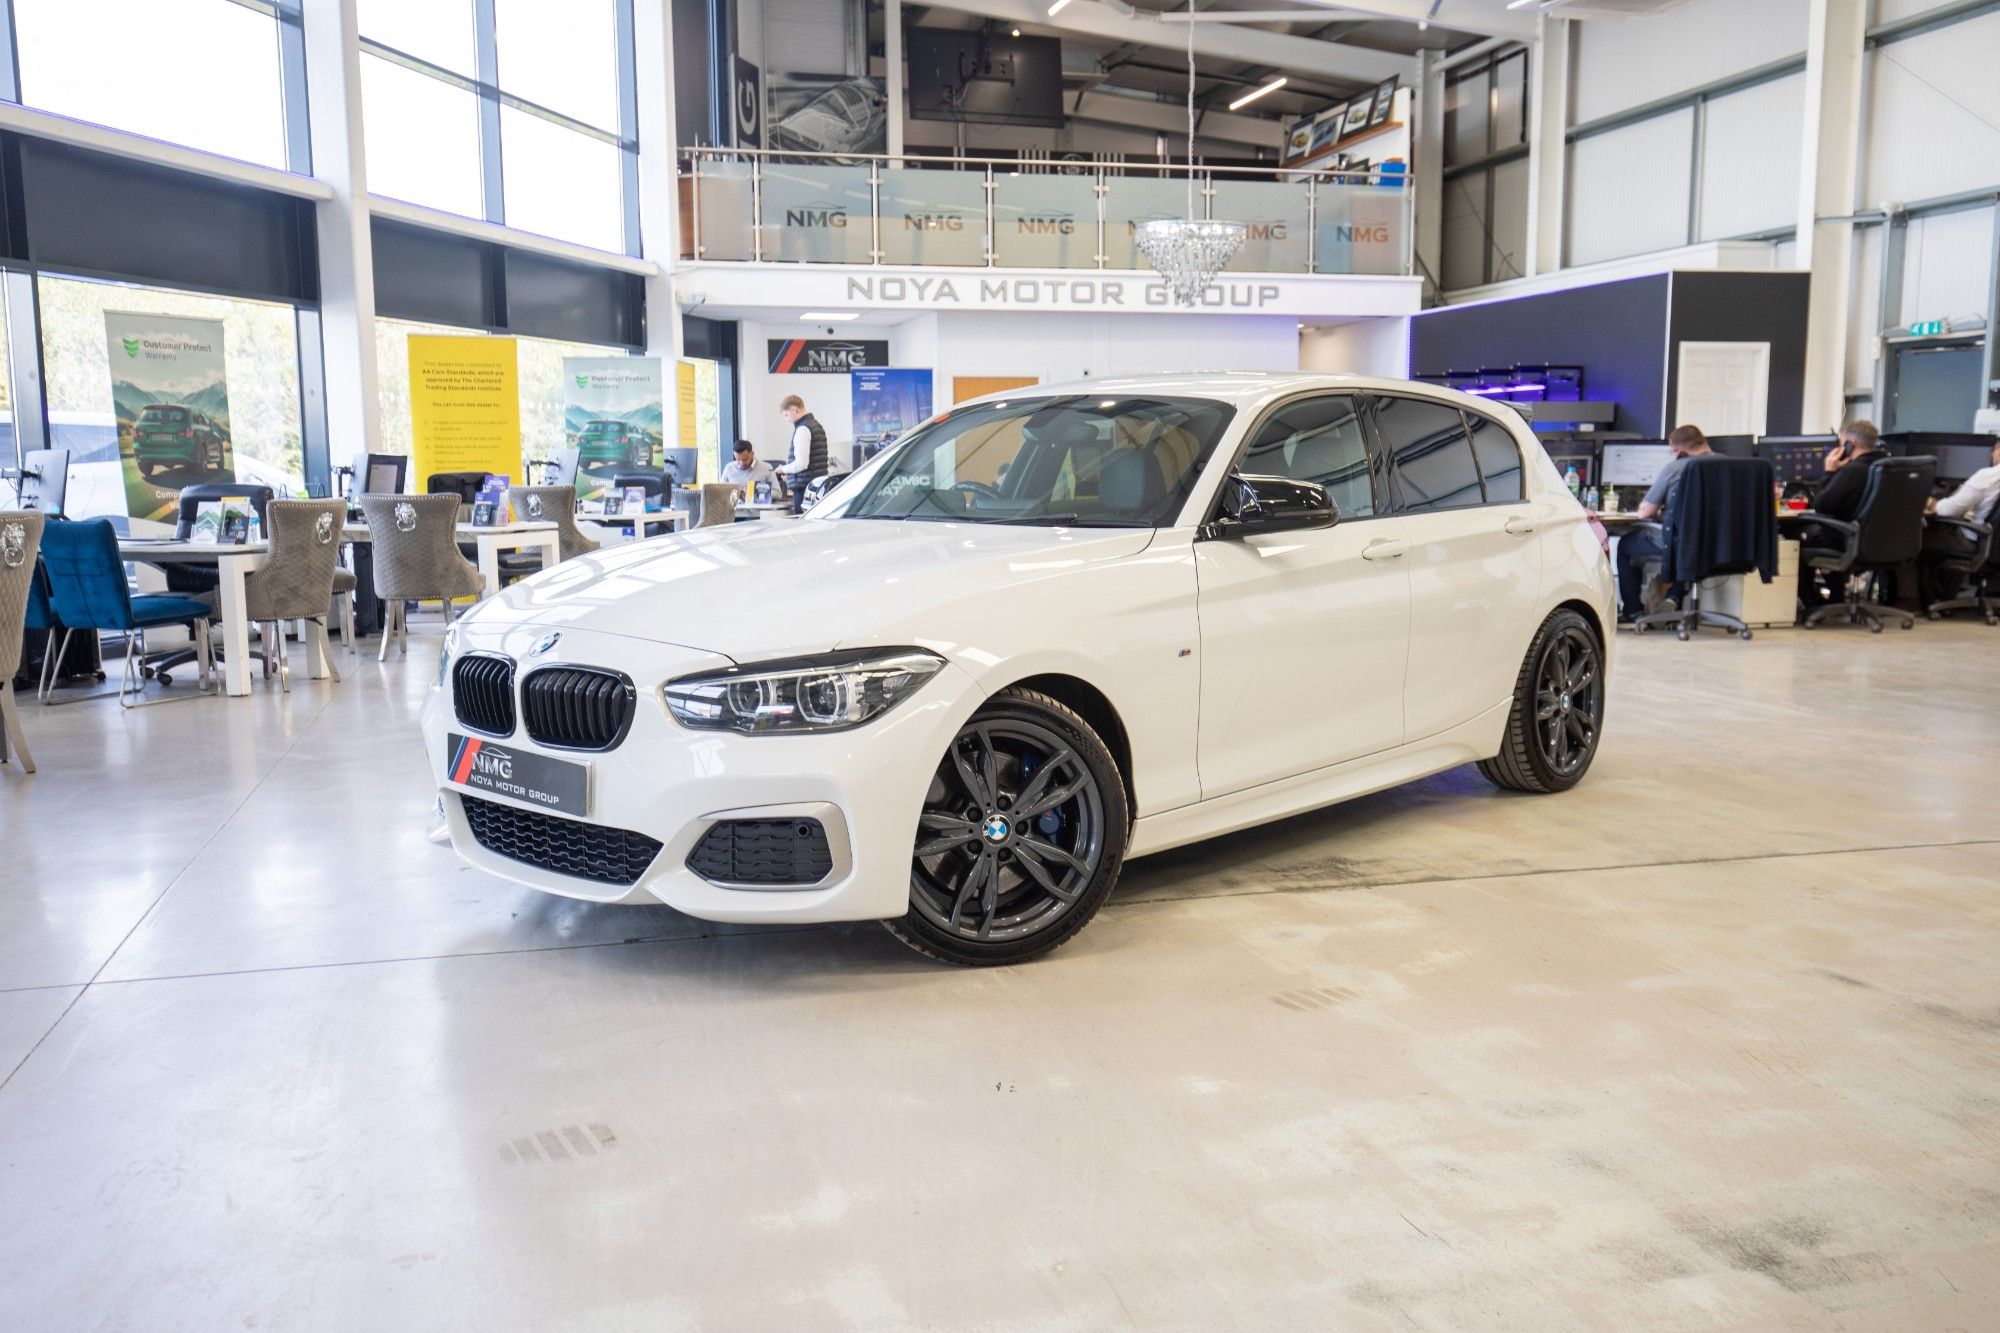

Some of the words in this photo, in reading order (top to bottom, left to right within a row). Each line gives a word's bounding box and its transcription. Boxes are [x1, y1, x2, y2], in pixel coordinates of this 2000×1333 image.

[786, 210, 847, 228] NMG
[904, 213, 963, 232] NMG
[1017, 217, 1075, 235] NMG
[1336, 226, 1388, 243] NMG
[847, 277, 960, 302] NOYA
[980, 280, 1125, 305] MOTOR
[143, 340, 181, 350] Customer
[184, 343, 212, 352] Protect
[144, 352, 177, 360] Warranty
[807, 350, 866, 367] NMG
[471, 751, 513, 779] NMG
[470, 773, 493, 787] NOYA
[495, 781, 526, 796] MOTOR
[528, 789, 560, 805] GROUP
